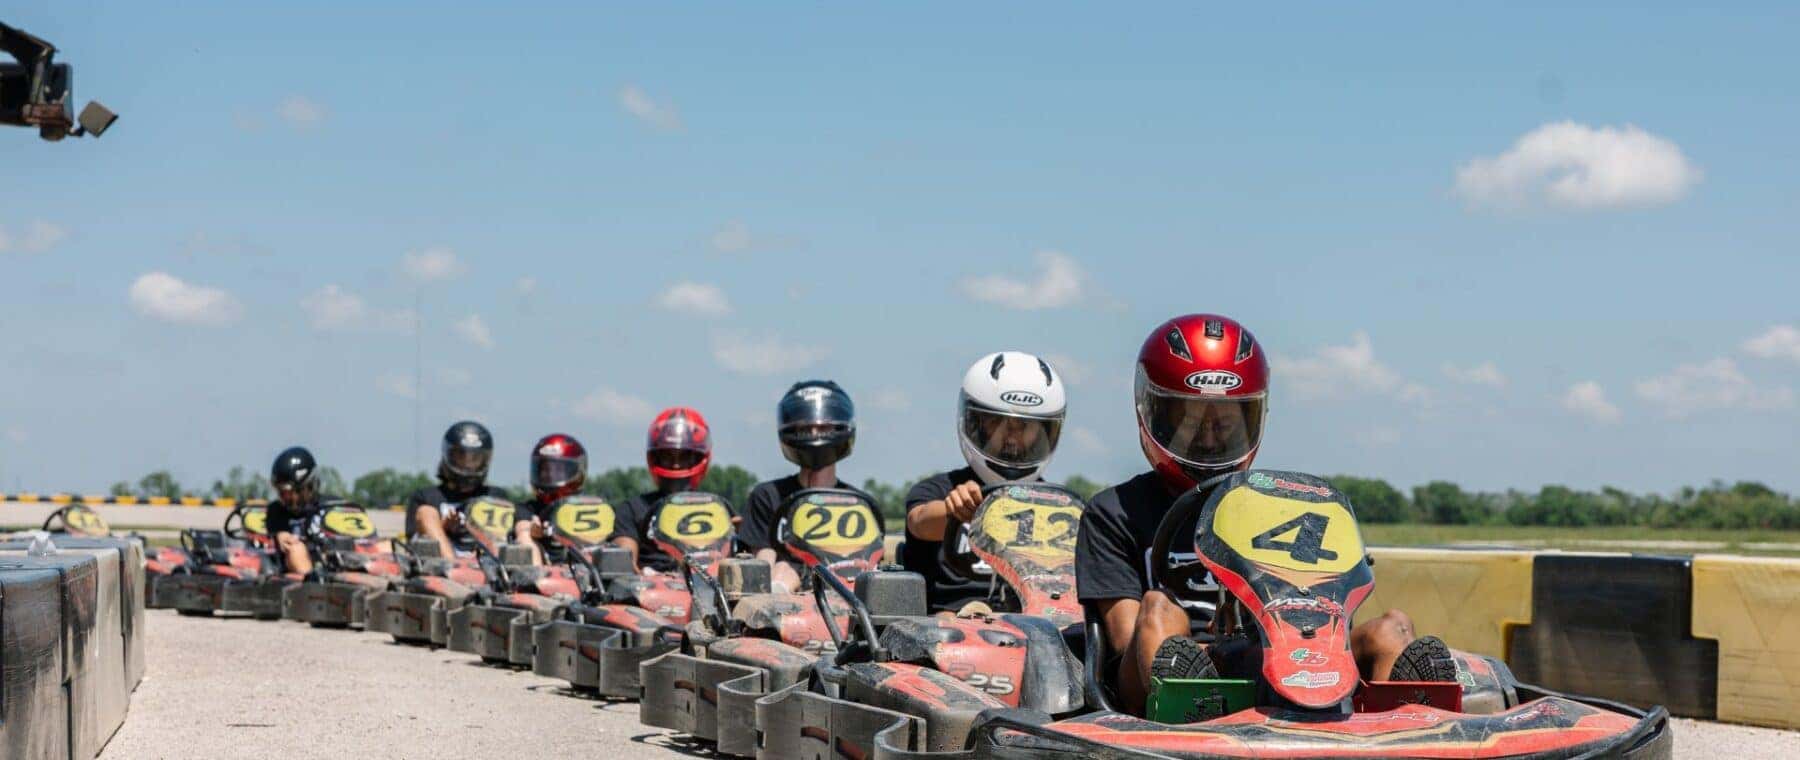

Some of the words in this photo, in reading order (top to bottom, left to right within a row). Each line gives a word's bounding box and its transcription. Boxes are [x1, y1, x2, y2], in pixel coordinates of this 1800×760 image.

[1193, 375, 1235, 385] HJC
[573, 510, 601, 532] 5
[676, 510, 715, 536] 6
[803, 507, 867, 540] 20
[1005, 508, 1079, 551] 12
[1251, 511, 1339, 565] 4
[968, 673, 1014, 696] 25
